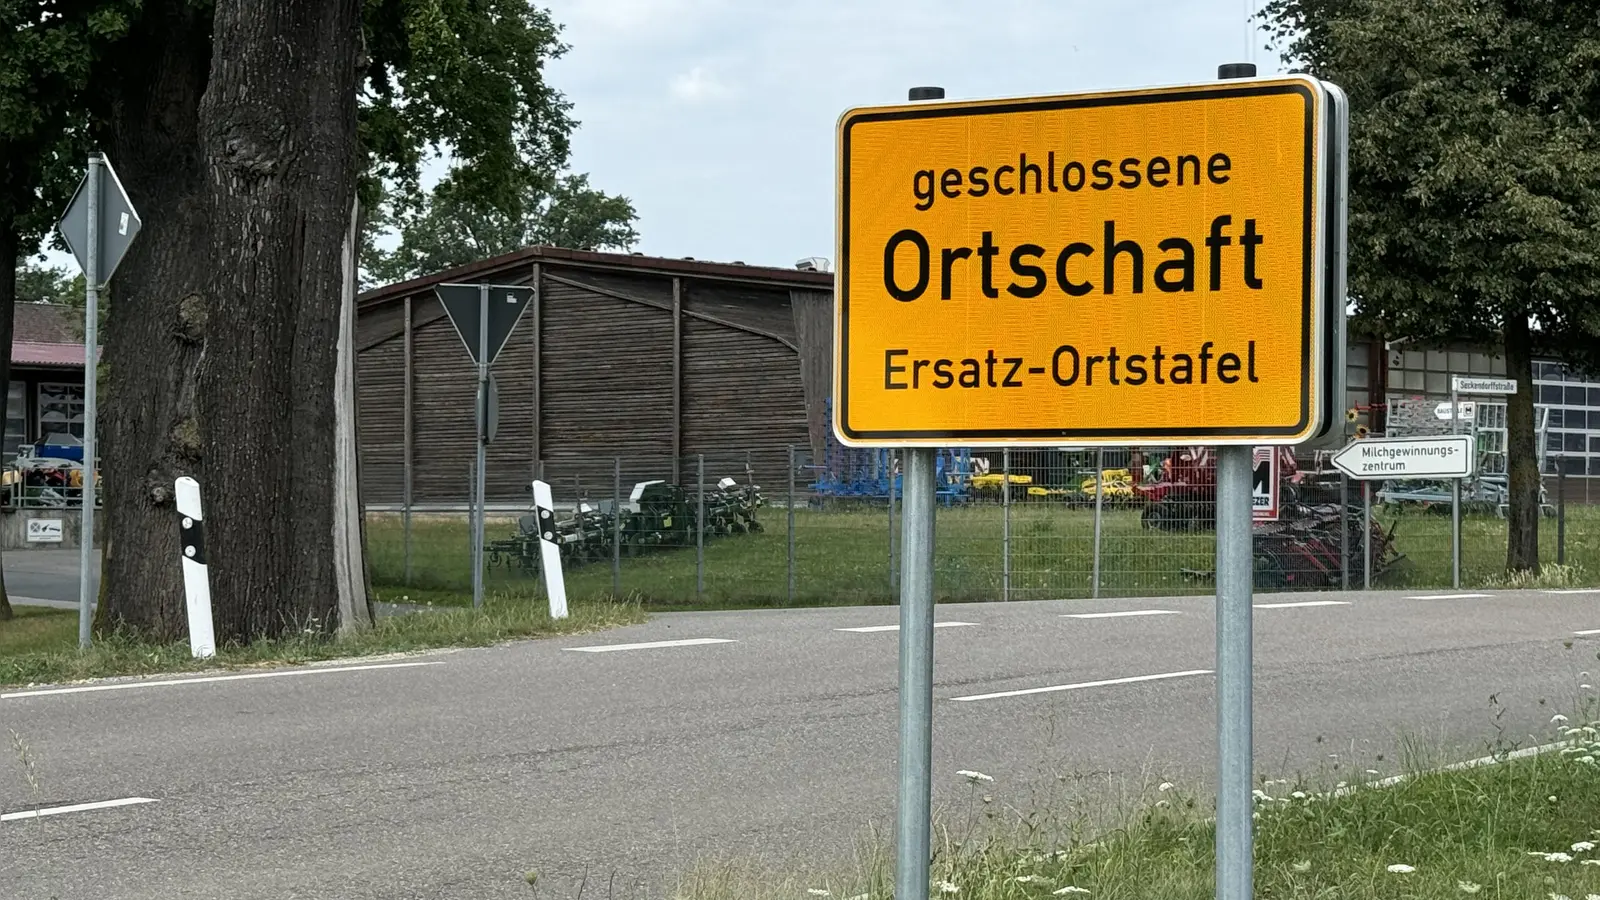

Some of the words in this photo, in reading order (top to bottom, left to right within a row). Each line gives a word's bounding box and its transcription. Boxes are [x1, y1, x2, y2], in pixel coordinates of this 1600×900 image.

[913, 151, 1232, 211] geschlossene
[883, 214, 1264, 303] Ortschaft
[884, 340, 1259, 390] Ersatz-Ortstafel
[1460, 380, 1515, 392] Seckendorffstraße
[1361, 445, 1460, 460] Milchgewinnungs-
[1361, 461, 1406, 472] zentrum
